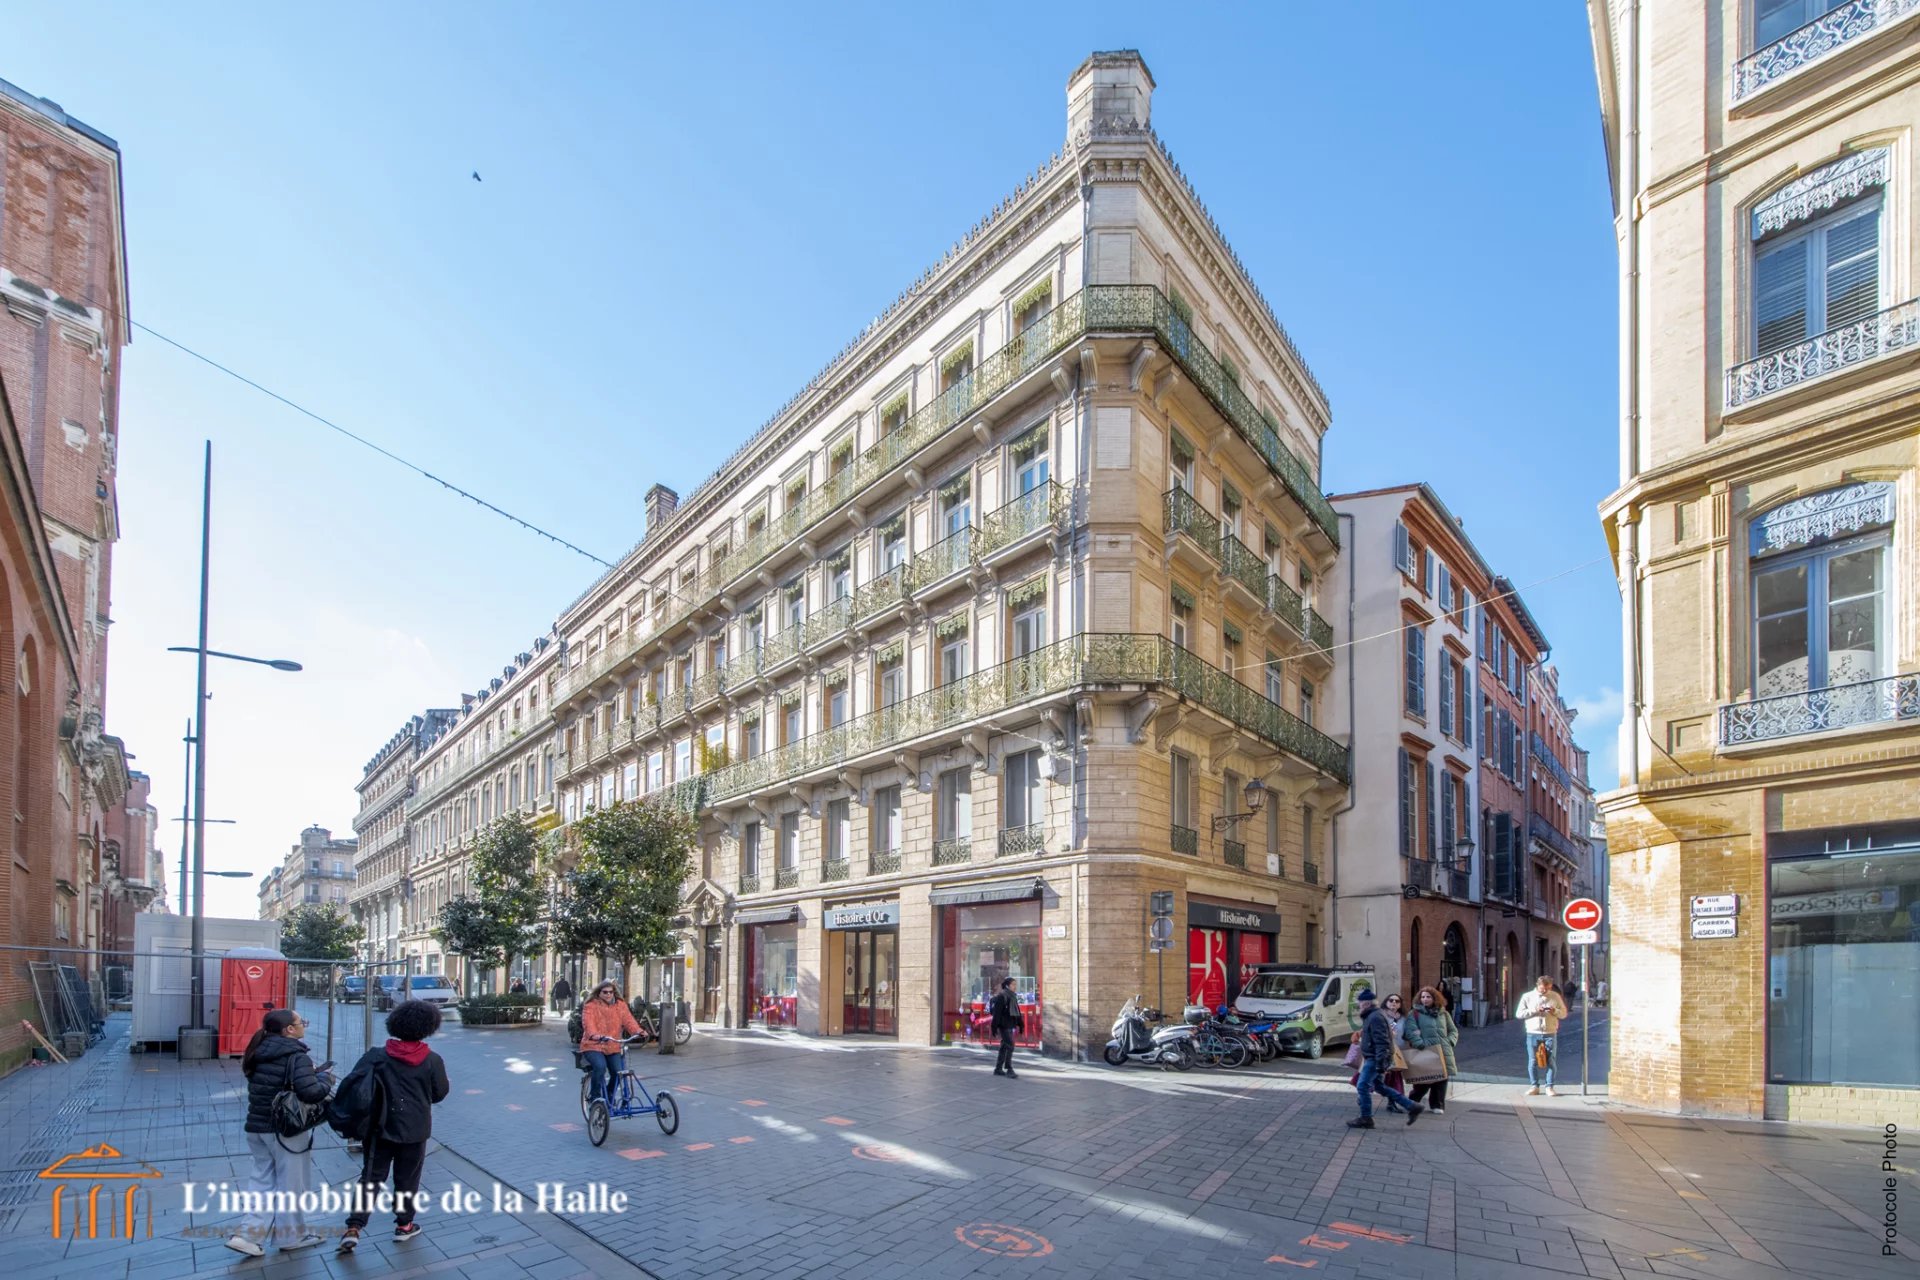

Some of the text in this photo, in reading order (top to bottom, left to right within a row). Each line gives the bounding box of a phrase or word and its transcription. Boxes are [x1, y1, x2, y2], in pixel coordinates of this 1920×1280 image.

[833, 910, 885, 925] Histoire d'Or
[1220, 910, 1261, 927] Histoire d'Or
